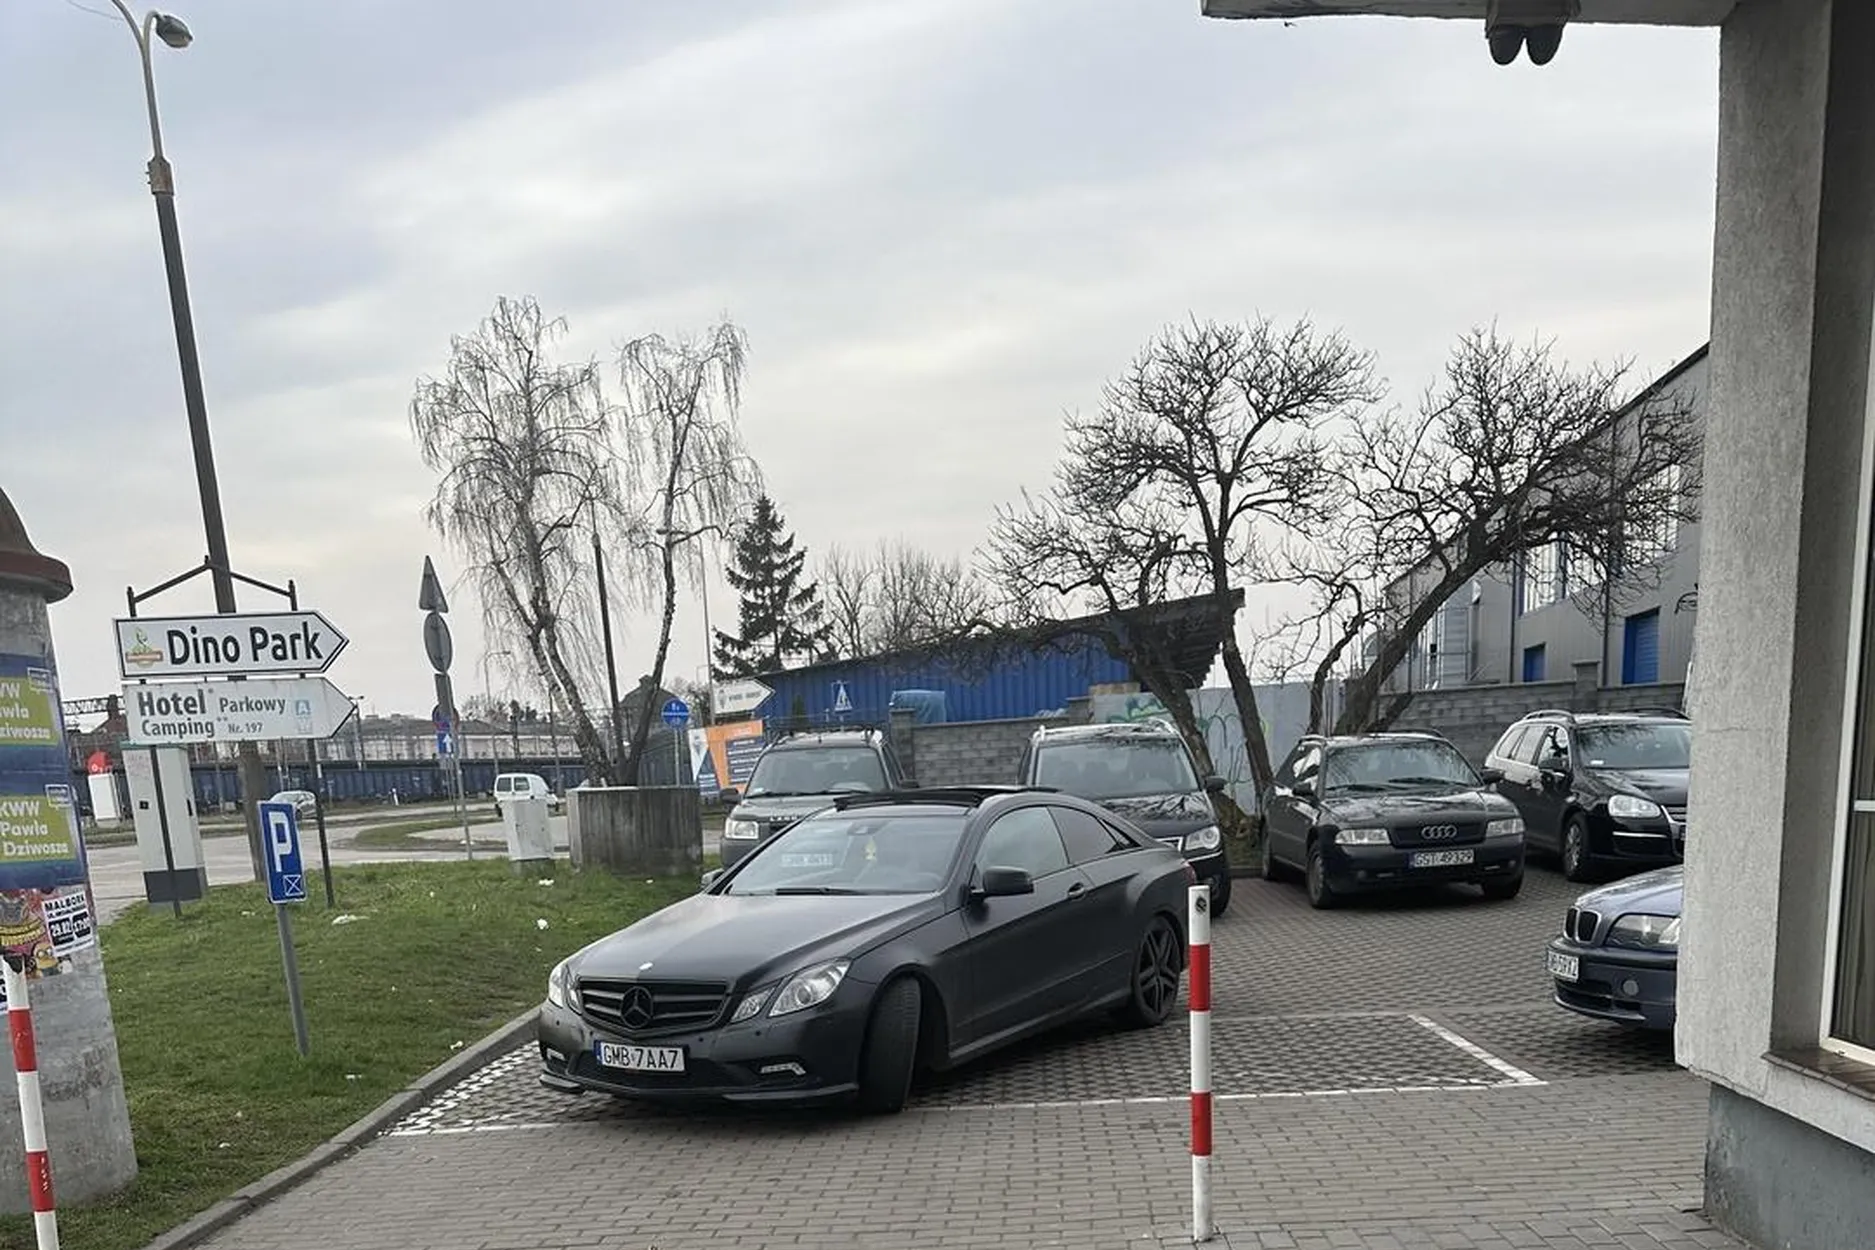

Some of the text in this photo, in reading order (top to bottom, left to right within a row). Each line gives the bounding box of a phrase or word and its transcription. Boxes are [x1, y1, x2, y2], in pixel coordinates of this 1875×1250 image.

[167, 621, 323, 665] Dino Park
[136, 689, 286, 716] Hotel Parkowy
[141, 717, 215, 739] Camping
[245, 722, 263, 733] 197
[3, 840, 69, 857] Dziwosza
[268, 811, 292, 872] P
[604, 1044, 678, 1069] GMB 7AA7
